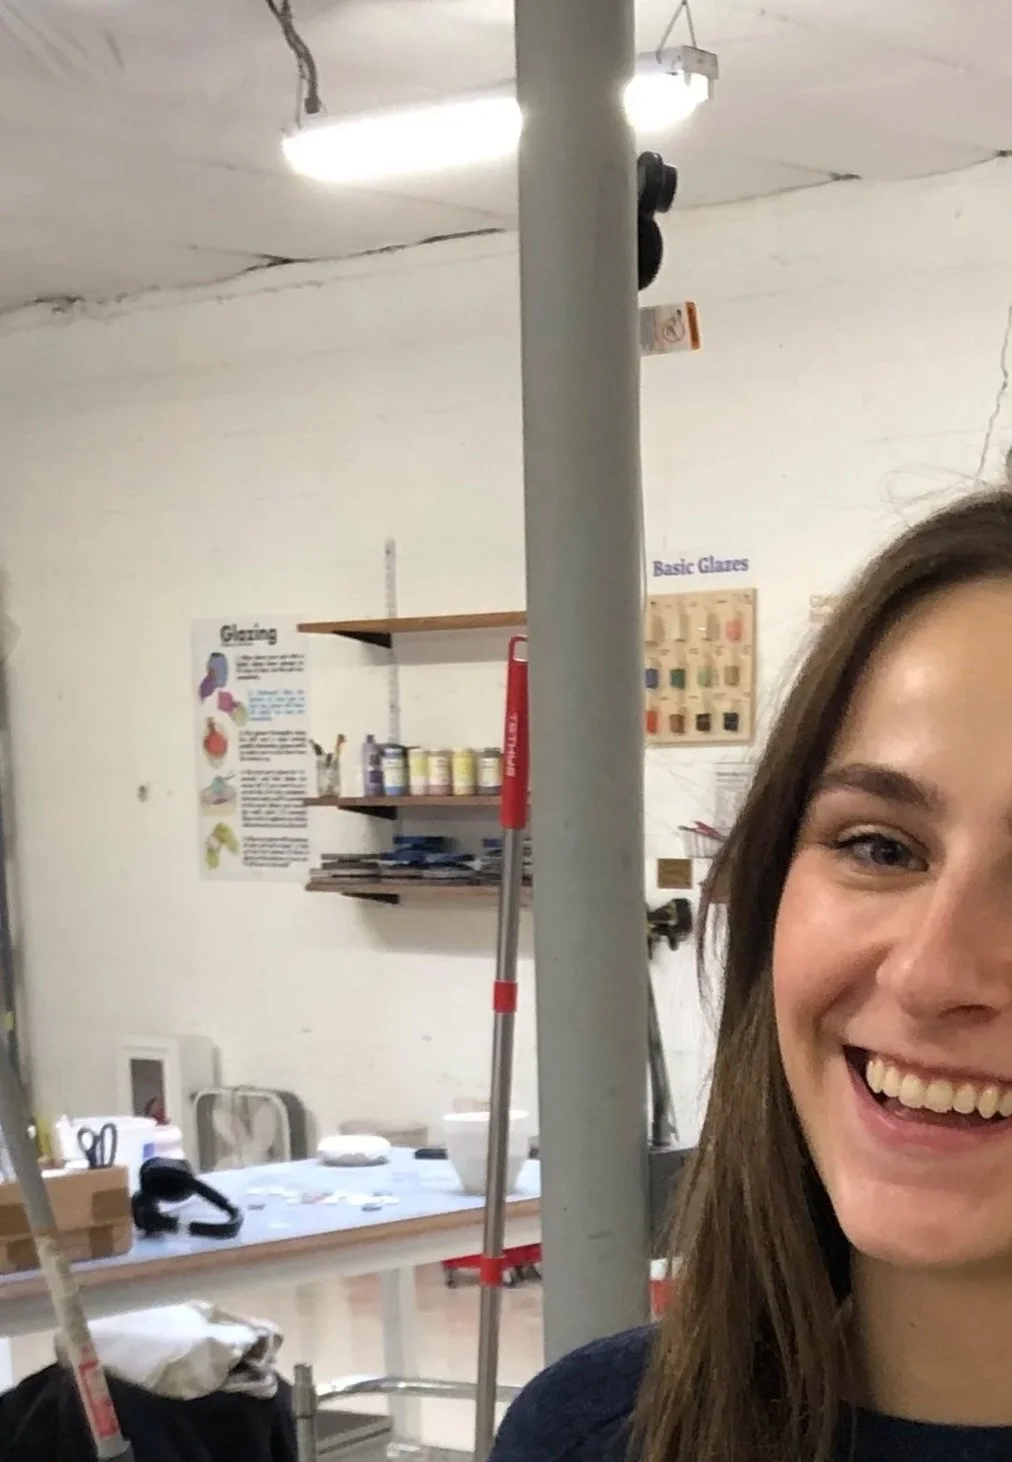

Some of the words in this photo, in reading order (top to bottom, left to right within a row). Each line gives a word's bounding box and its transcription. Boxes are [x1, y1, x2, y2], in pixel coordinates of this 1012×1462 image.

[653, 558, 695, 577] Basic
[698, 555, 749, 574] Glazes
[220, 623, 277, 646] Glazing
